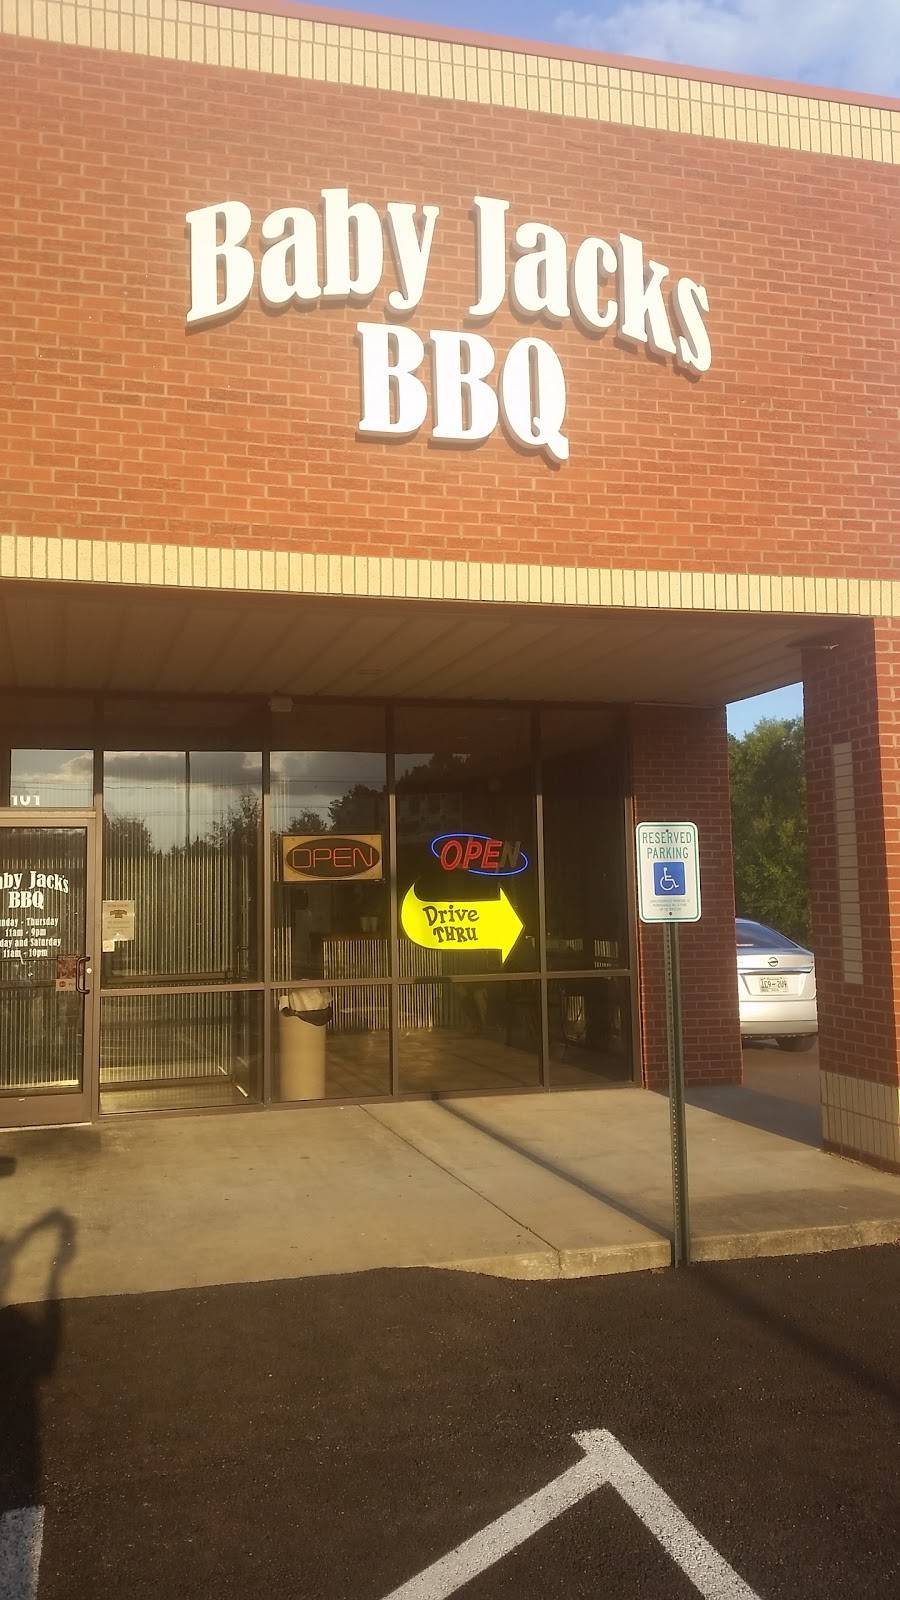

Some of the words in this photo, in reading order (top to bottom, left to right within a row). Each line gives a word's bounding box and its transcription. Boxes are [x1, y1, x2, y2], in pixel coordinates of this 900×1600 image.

[185, 188, 440, 323] Baby
[468, 196, 712, 373] Jacks
[357, 322, 569, 461] BBQ
[642, 832, 692, 844] RESERVED
[292, 847, 374, 869] OPEN
[440, 839, 521, 871] OPEN
[647, 847, 689, 859] PARKING
[8, 891, 44, 910] BBQ
[26, 916, 58, 927] Thursday
[422, 904, 480, 926] Drive
[5, 928, 23, 937] 11am
[31, 928, 46, 937] 9pm
[433, 926, 479, 943] THRU
[15, 938, 28, 947] and
[31, 938, 61, 947] Saturday
[3, 949, 21, 958] 11am
[29, 948, 48, 958] 10pm
